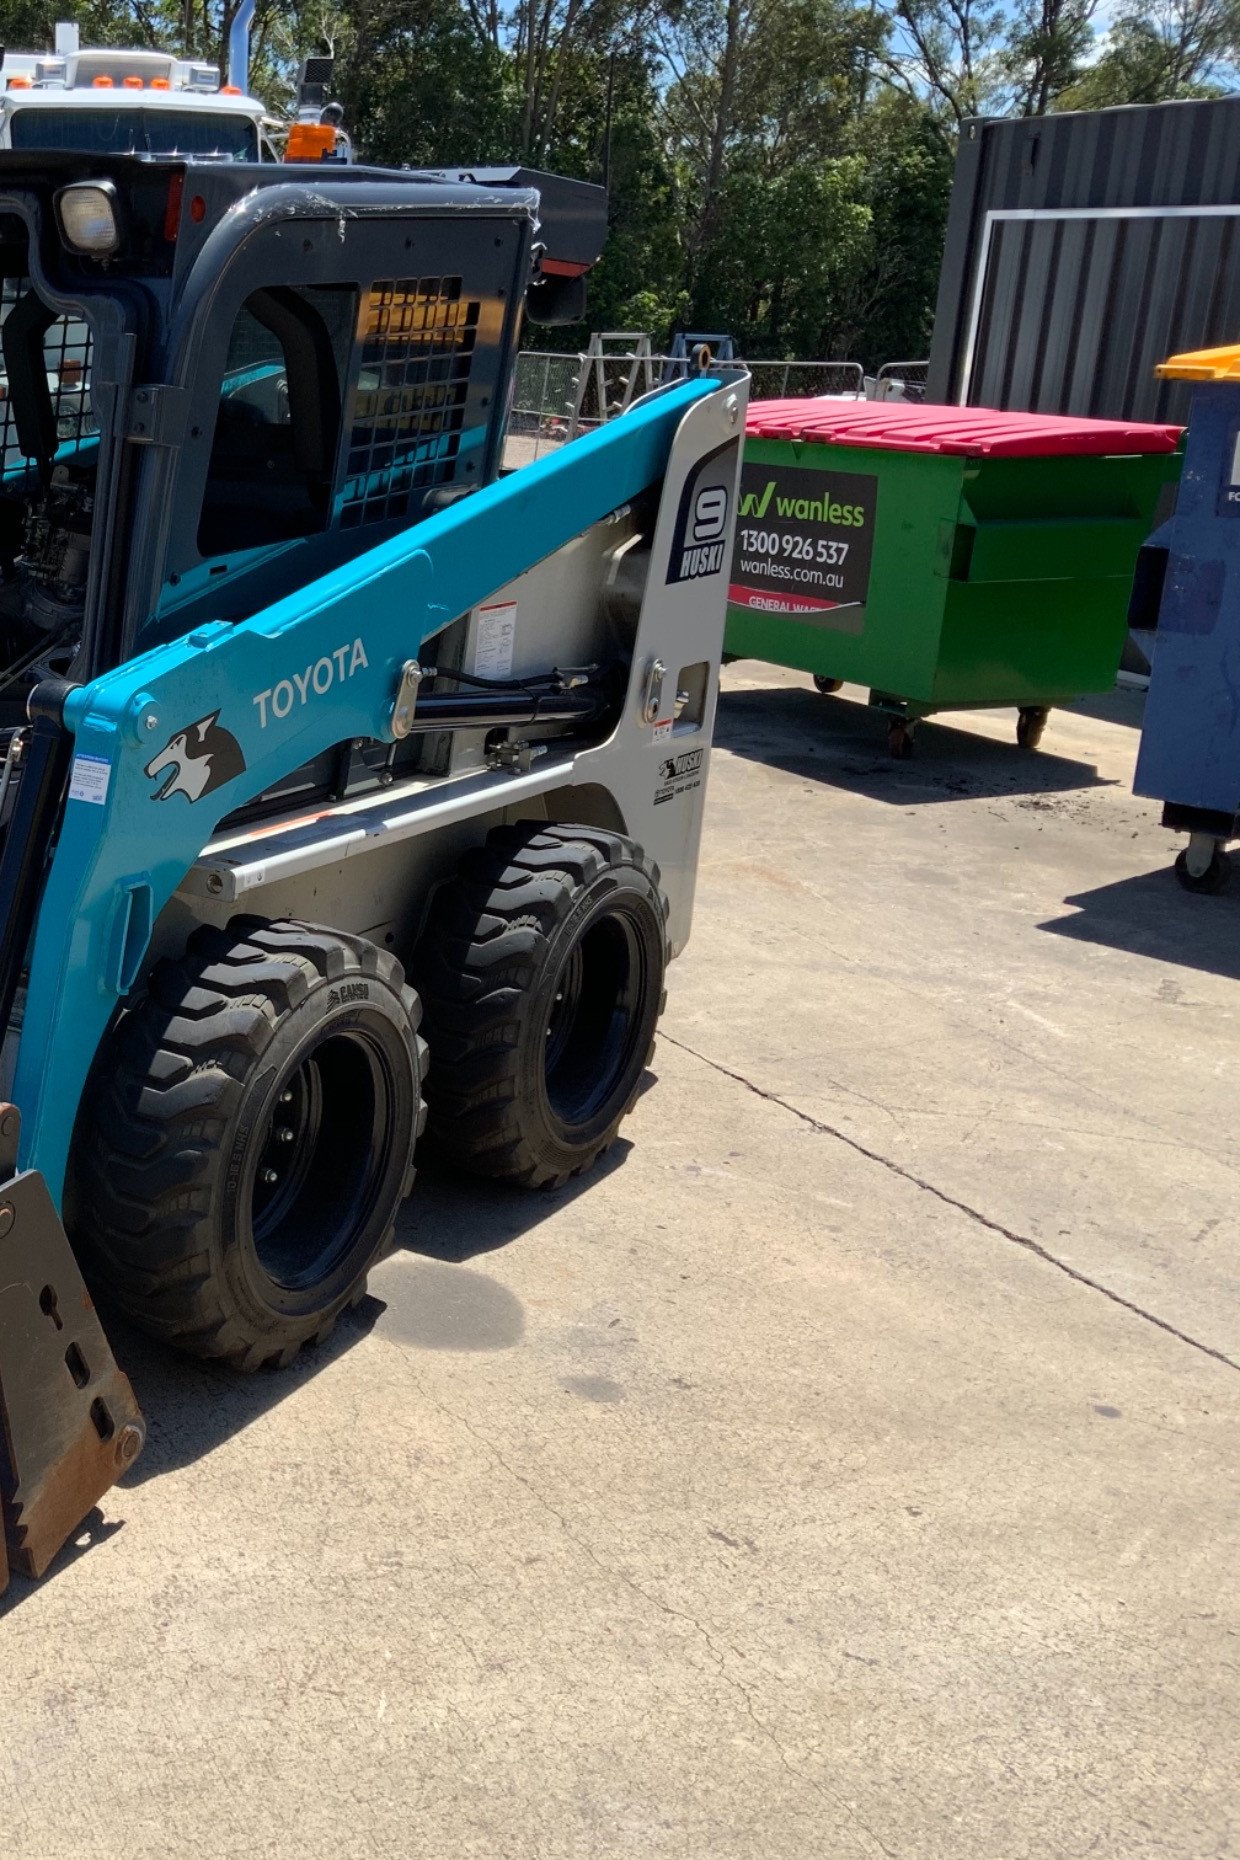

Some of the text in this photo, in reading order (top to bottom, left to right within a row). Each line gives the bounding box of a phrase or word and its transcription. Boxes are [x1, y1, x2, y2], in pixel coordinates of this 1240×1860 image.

[693, 485, 728, 541] 9
[776, 491, 865, 528] wanless
[679, 543, 724, 578] HUSKI
[740, 529, 849, 566] 1300 926 537
[740, 557, 844, 588] wanless.com.au
[252, 637, 369, 729] TOYOTA
